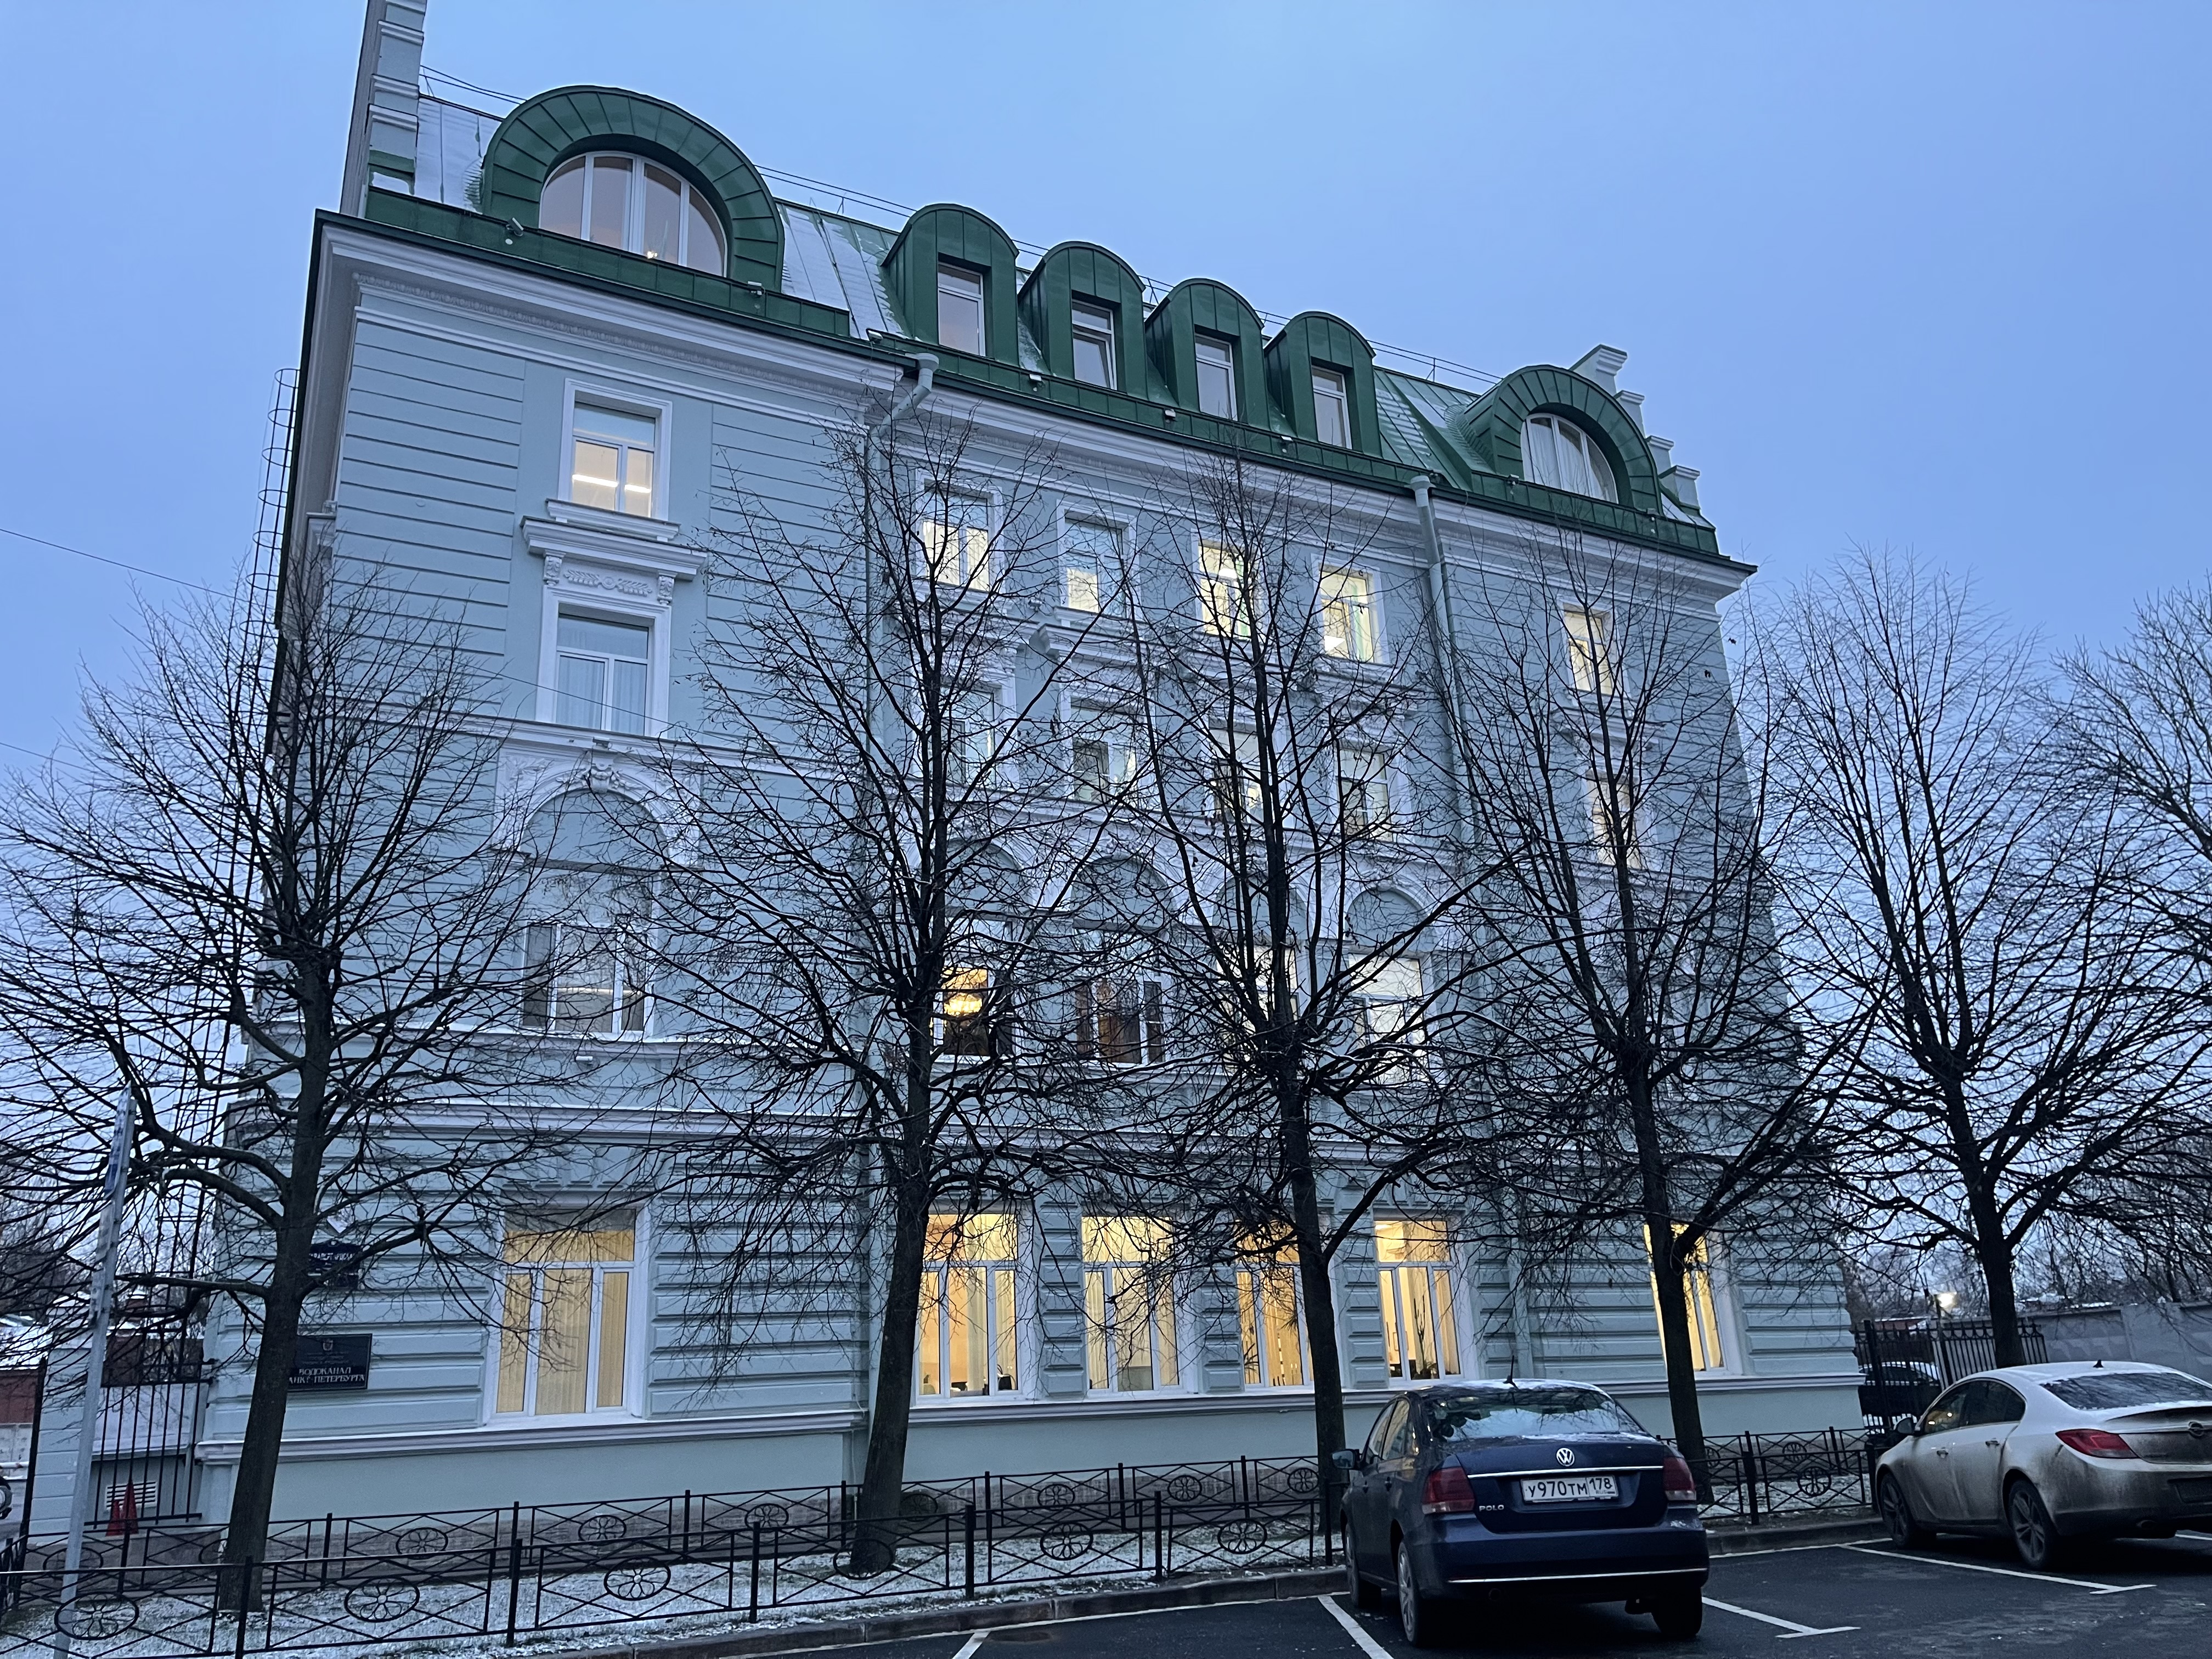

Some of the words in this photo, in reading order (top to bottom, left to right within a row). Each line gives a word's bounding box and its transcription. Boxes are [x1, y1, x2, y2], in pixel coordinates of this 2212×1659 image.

[299, 1367, 351, 1376] ВОДОКАНАЛ
[289, 1374, 365, 1384] АНКТ-ПЕТЕРБУРГА
[1528, 1481, 1588, 1498] У970ТМ
[1589, 1477, 1613, 1490] 178
